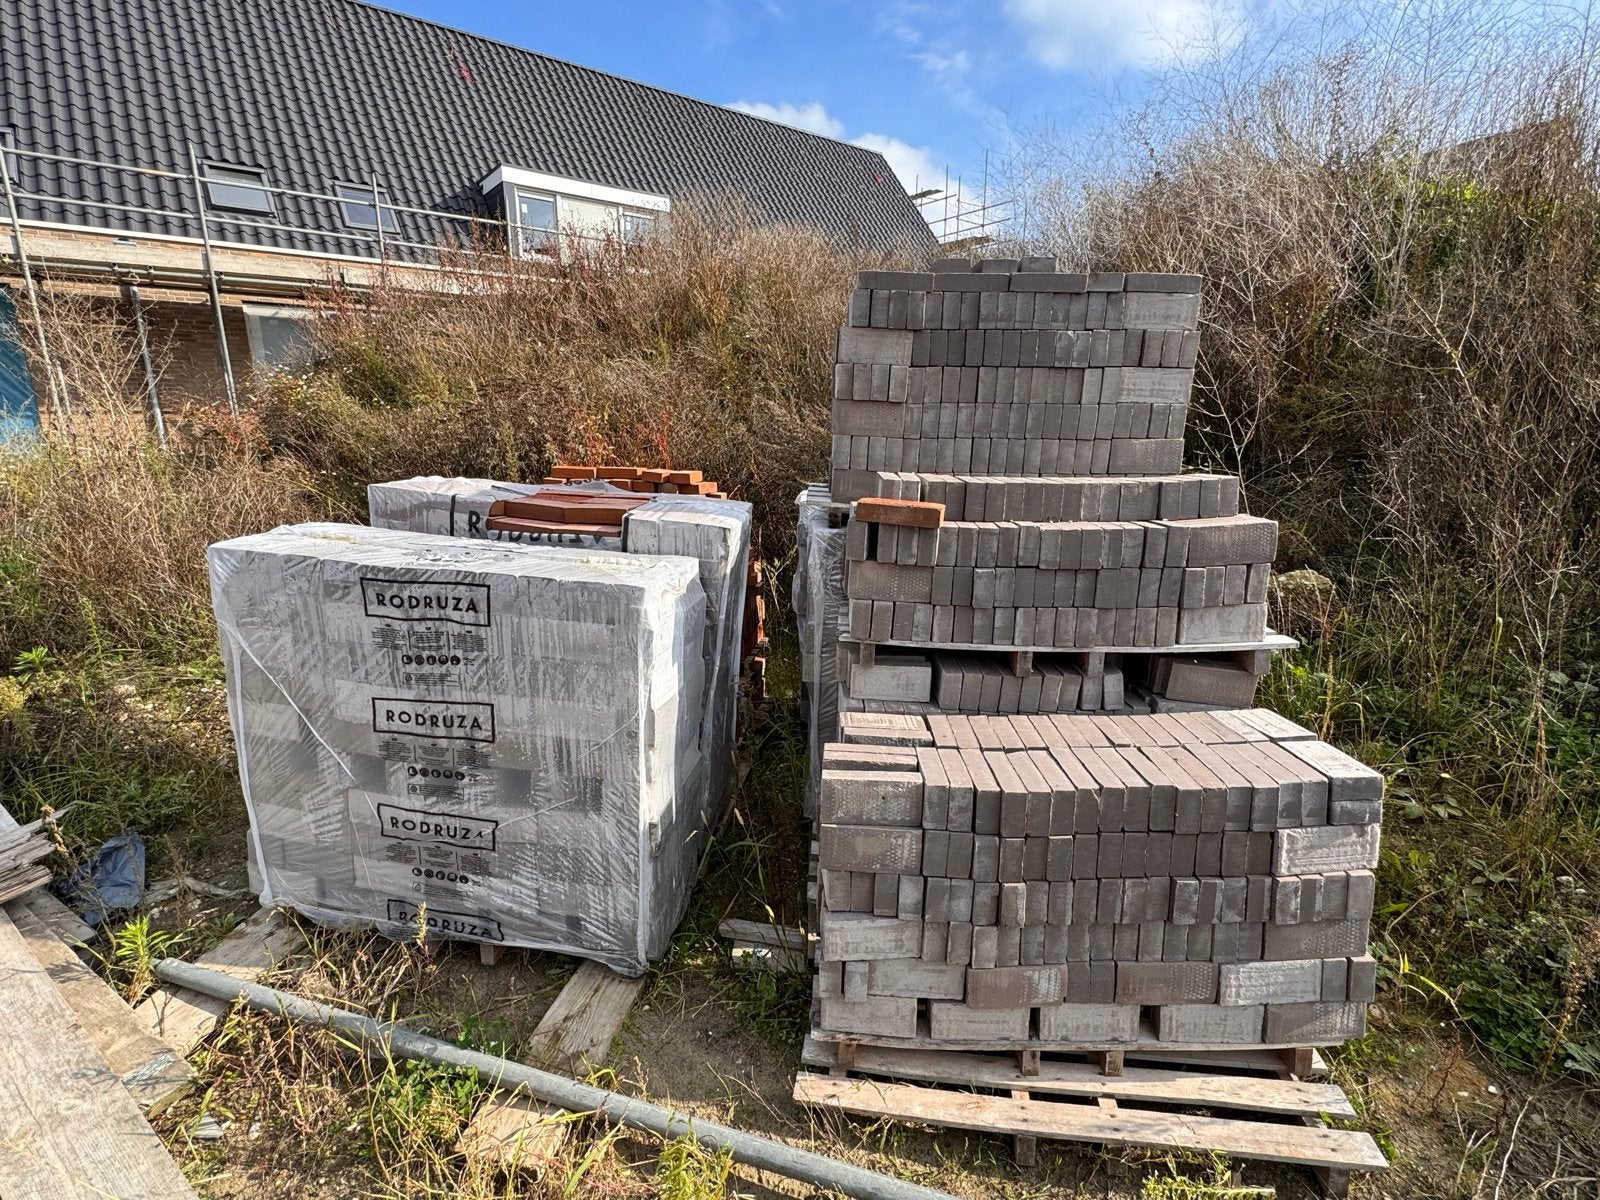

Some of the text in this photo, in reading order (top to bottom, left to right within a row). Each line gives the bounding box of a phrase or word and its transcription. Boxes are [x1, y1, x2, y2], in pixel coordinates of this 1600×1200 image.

[375, 592, 479, 614] RODRUZA
[385, 709, 483, 731] RODRUZA
[389, 816, 484, 840] RODRUZA
